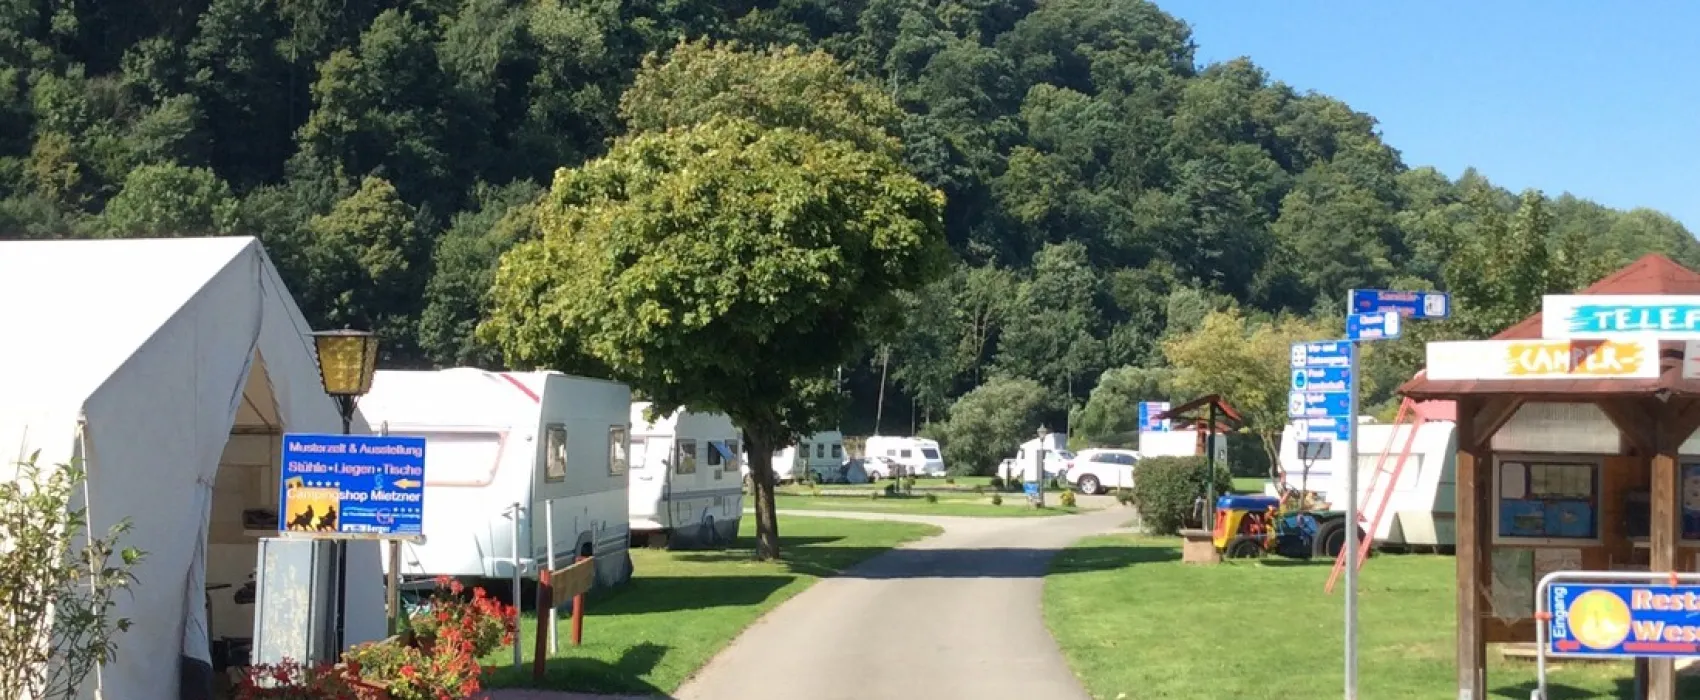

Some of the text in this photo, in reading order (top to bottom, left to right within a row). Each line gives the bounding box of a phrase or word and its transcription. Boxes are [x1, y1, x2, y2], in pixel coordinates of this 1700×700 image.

[289, 441, 422, 457] Musterzelt & Ausstellung
[288, 461, 422, 476] Stühle Liegen Tische
[1552, 586, 1569, 638] Eingang
